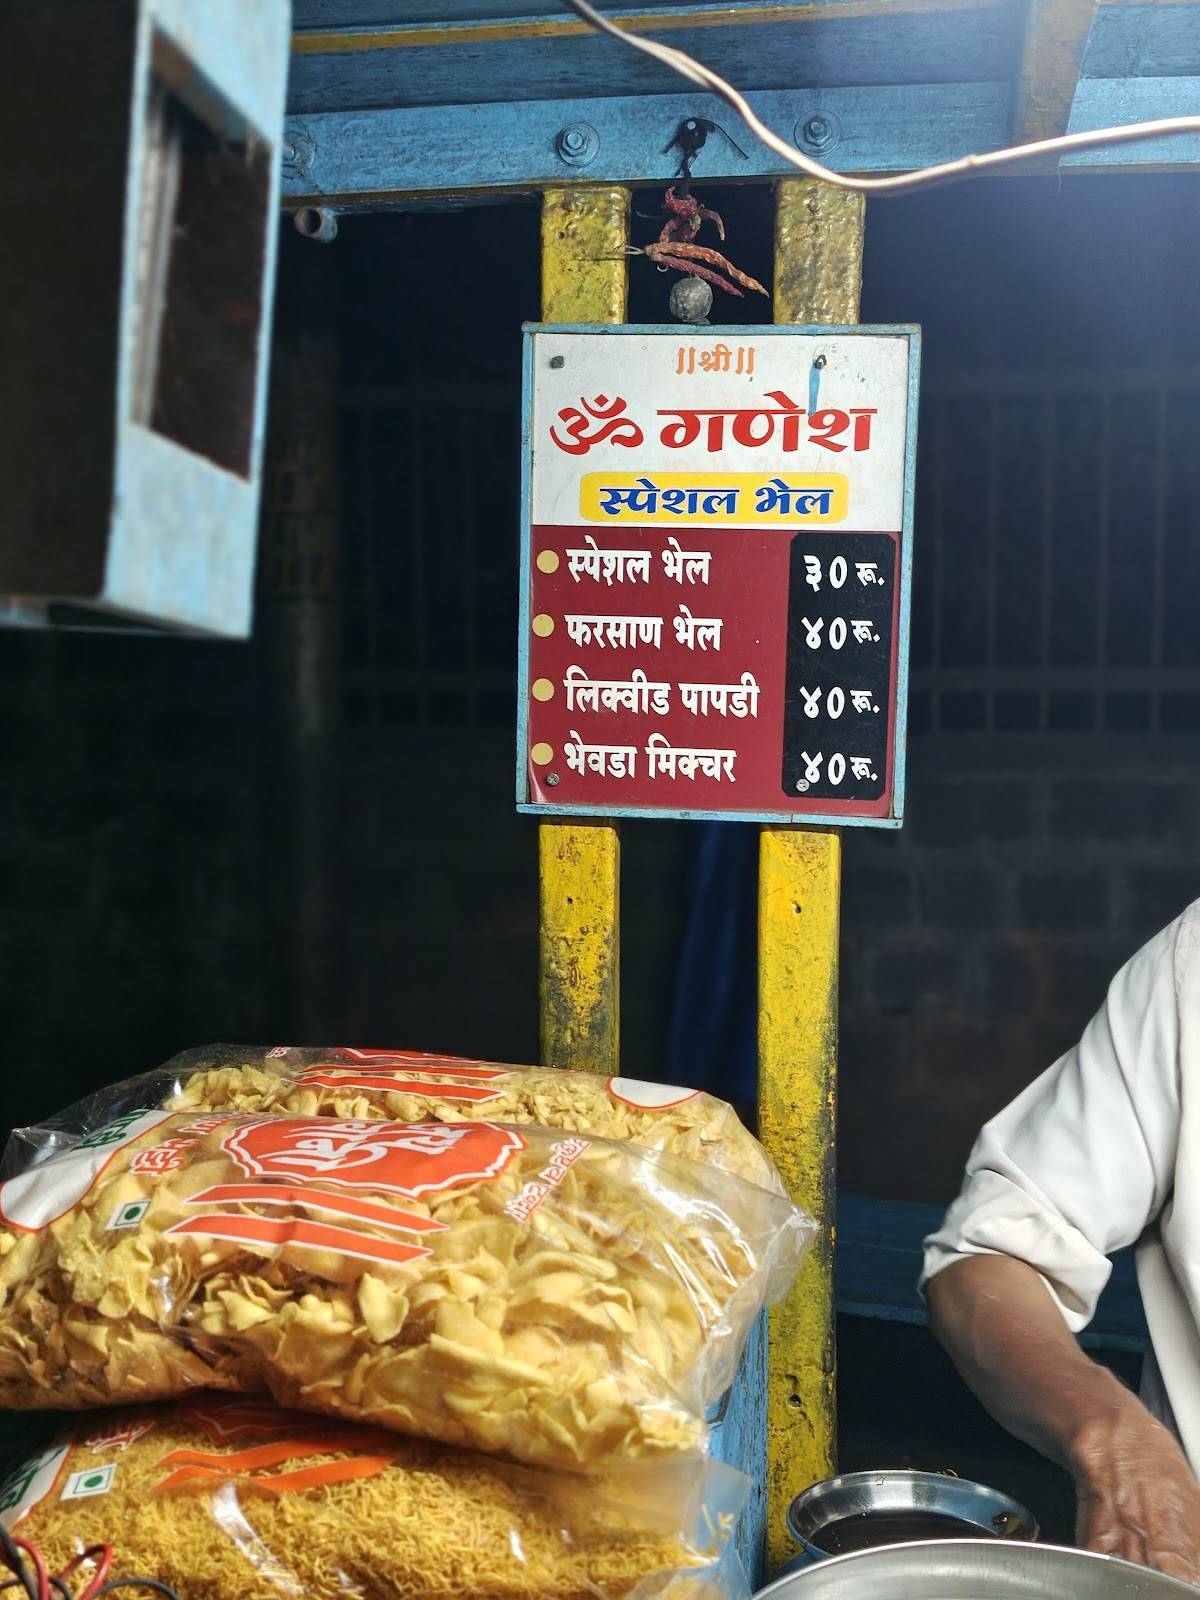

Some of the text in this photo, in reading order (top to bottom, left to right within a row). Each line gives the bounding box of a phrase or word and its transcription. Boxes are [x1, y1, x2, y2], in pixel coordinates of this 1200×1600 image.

[657, 391, 877, 452] गणेश
[599, 477, 834, 515] स्पेशल भेल
[566, 535, 652, 586] स्पेशल
[662, 537, 712, 584] भेल
[564, 615, 664, 649] फरसाण
[673, 604, 723, 651] भेल
[563, 665, 671, 715] लिक्वीड
[678, 672, 760, 718] पापडी
[564, 730, 637, 778] भेवडा
[645, 733, 737, 782] मिक्चर
